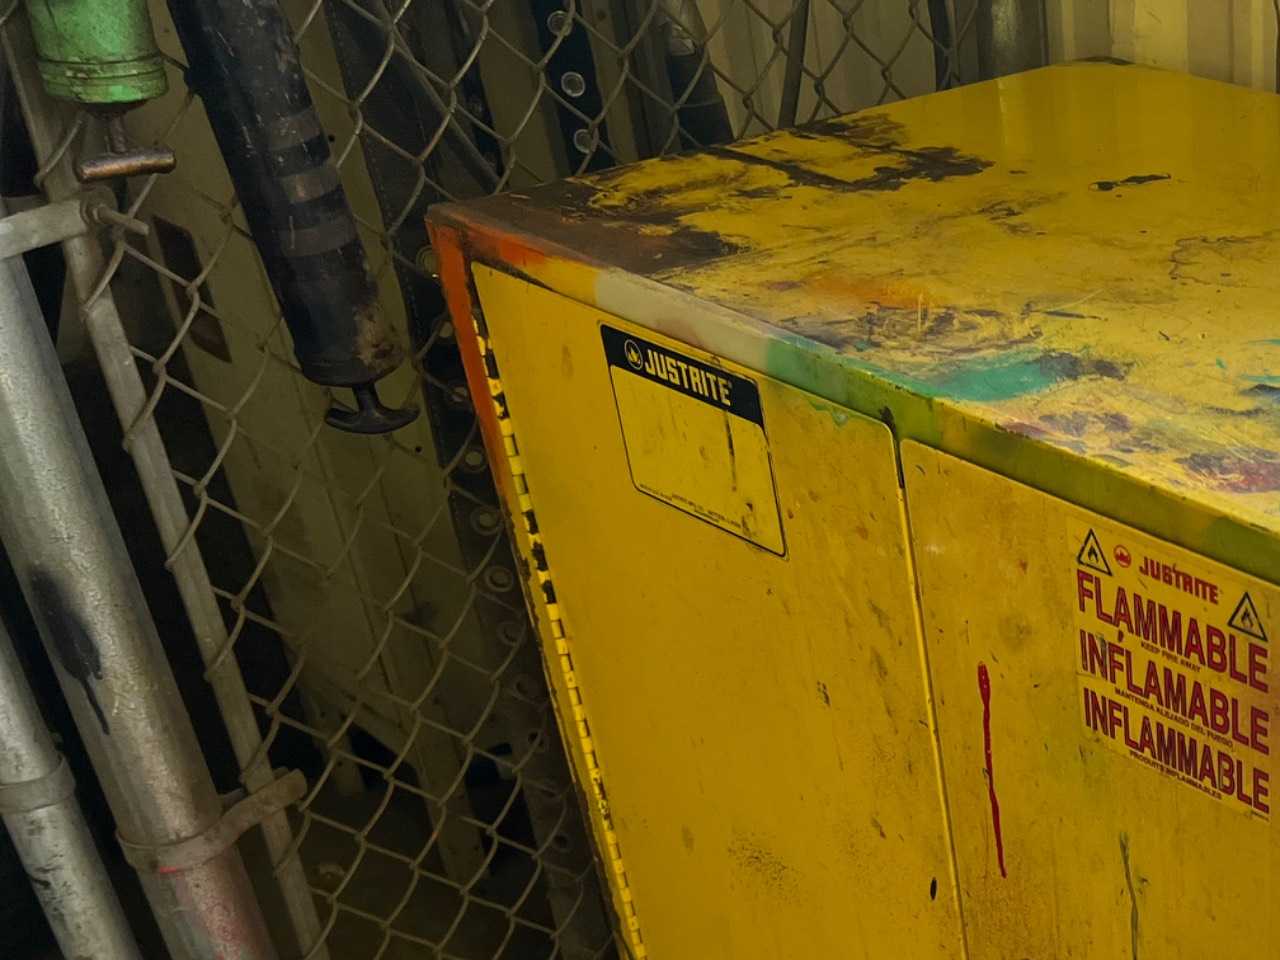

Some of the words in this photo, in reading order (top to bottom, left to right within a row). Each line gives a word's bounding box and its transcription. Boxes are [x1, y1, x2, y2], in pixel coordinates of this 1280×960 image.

[644, 349, 732, 406] JUSTRITE
[1077, 569, 1269, 693] FLAMMABLE
[1139, 556, 1219, 605] JUSTRITE
[1080, 630, 1270, 755] INFLAMABLE
[1083, 687, 1270, 814] INFLAMMABLE
